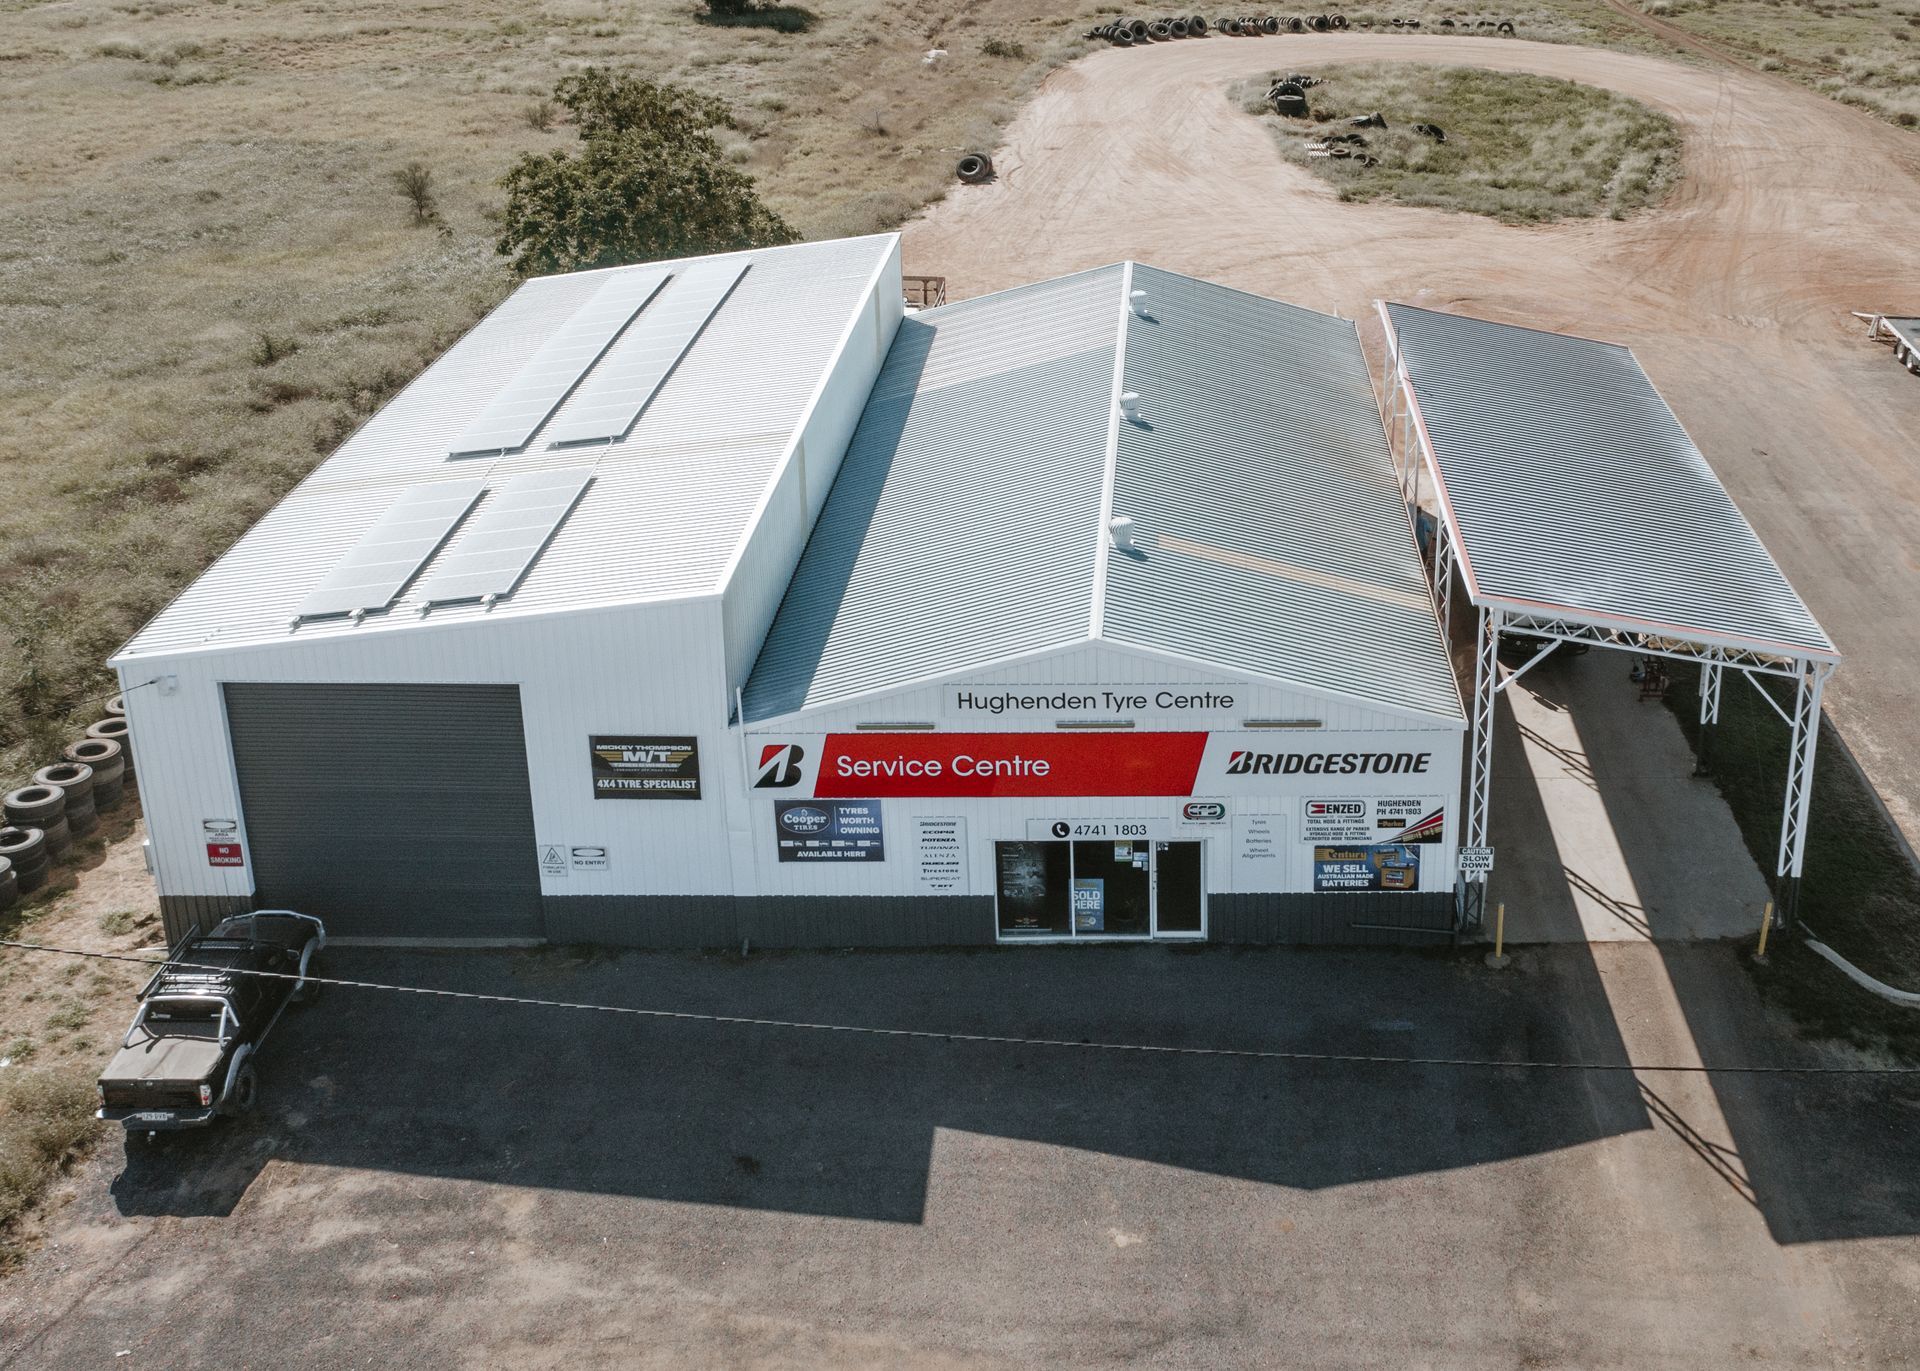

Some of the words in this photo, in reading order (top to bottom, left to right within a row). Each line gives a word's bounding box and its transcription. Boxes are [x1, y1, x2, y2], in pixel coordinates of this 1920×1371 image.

[958, 692, 1096, 714] Hughenden
[1102, 692, 1147, 712] Tyre
[1155, 691, 1234, 709] Centre
[622, 751, 671, 762] M/T
[836, 755, 942, 777] Service
[952, 755, 1050, 777] Centre
[1226, 751, 1431, 775] BRIDGESTONE
[597, 780, 616, 788] 4X4
[617, 780, 641, 788] TYRE
[643, 780, 696, 788] SPECIALIST
[1326, 804, 1361, 814] ENZED
[783, 813, 827, 825] Cooper
[1074, 825, 1106, 835] 4741
[1114, 825, 1147, 835] 1803
[1323, 865, 1340, 873] WE
[1343, 865, 1369, 873] SELL
[1073, 891, 1100, 900] SOLD
[1073, 901, 1101, 910] HERE
